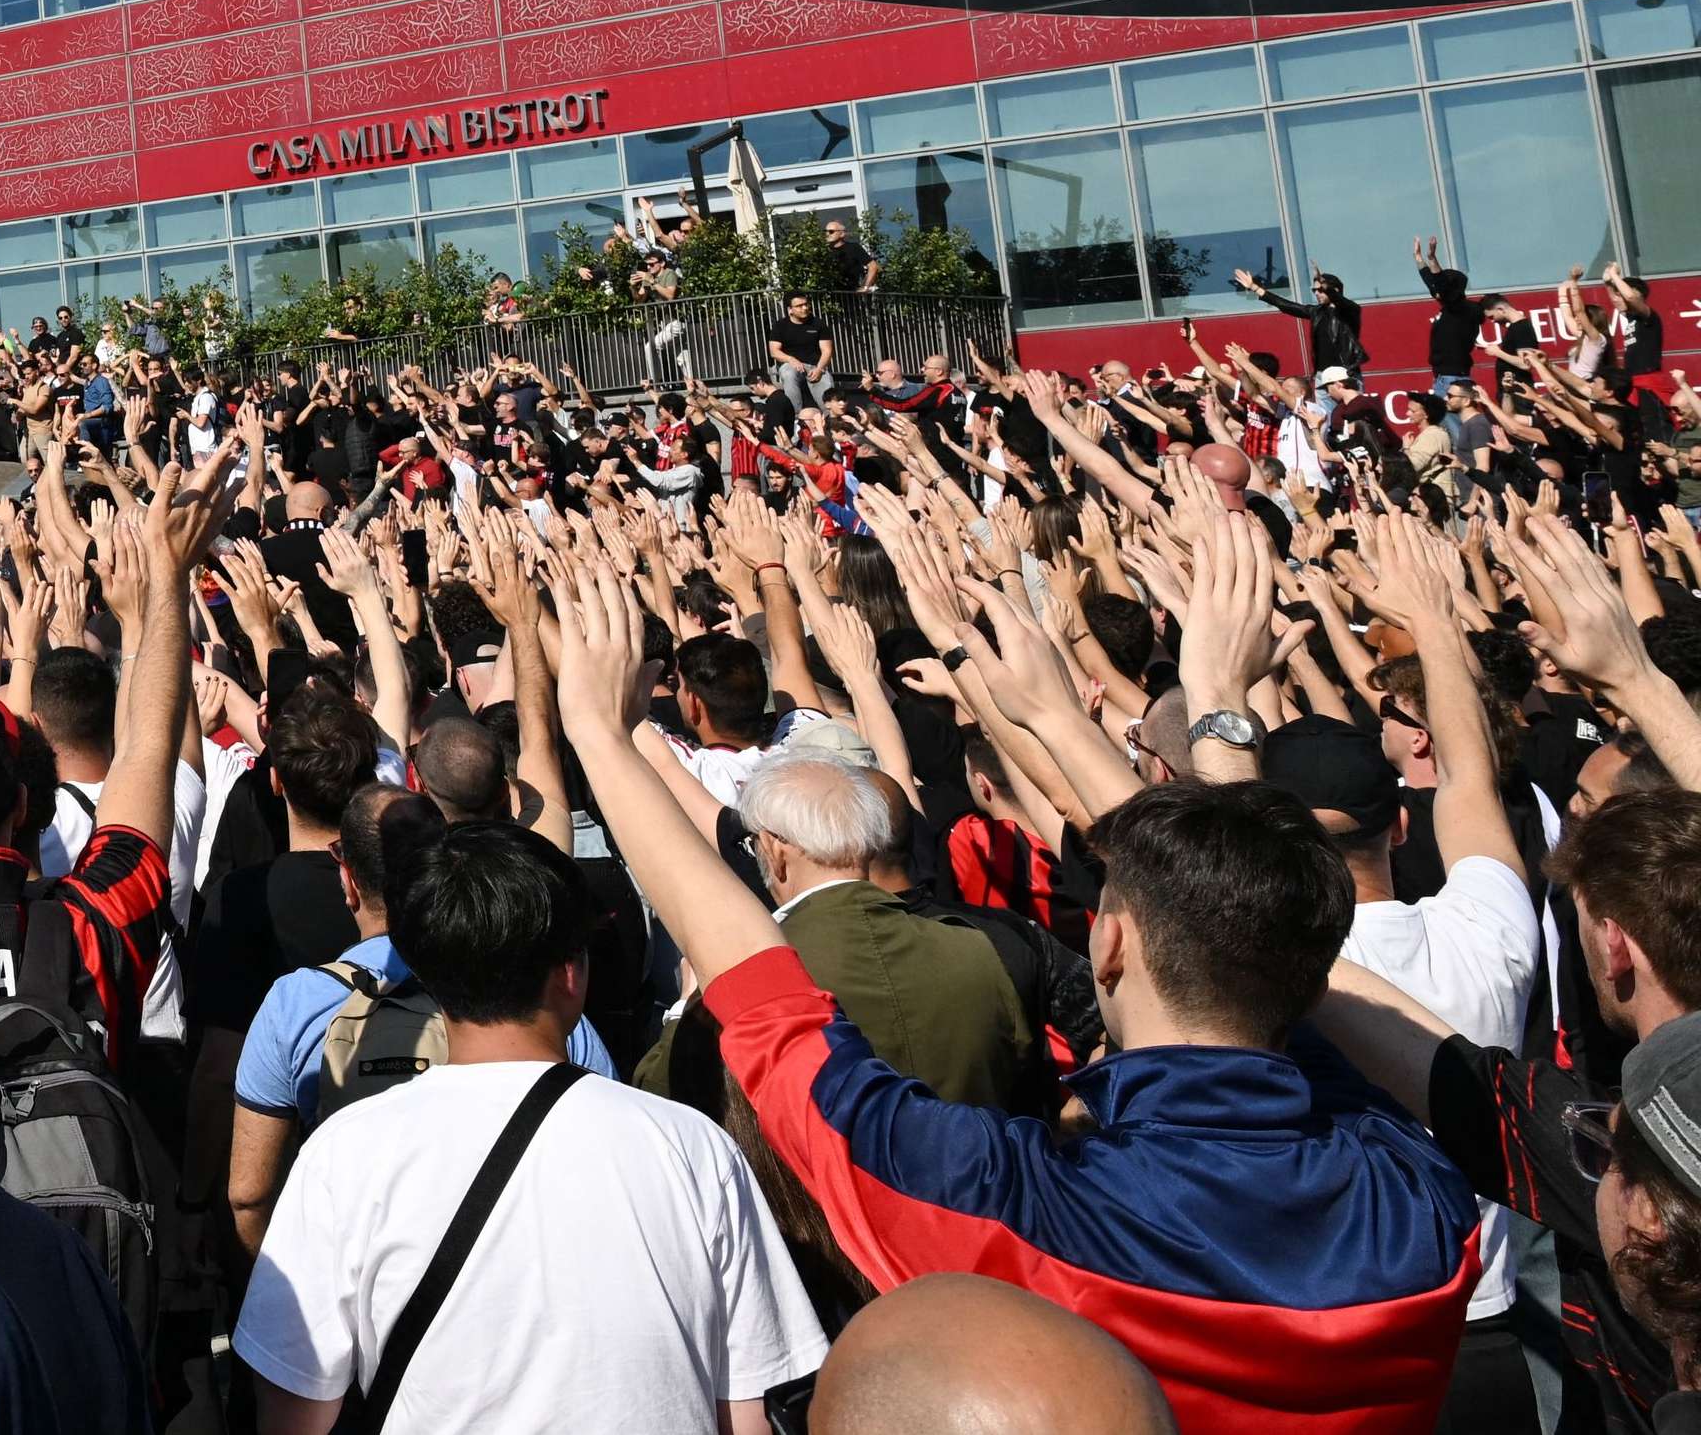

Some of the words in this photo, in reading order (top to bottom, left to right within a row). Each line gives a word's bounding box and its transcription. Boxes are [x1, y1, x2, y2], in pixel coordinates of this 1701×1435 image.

[247, 139, 335, 177] CASA
[339, 113, 453, 161] MILAN
[460, 89, 609, 145] BISTROT
